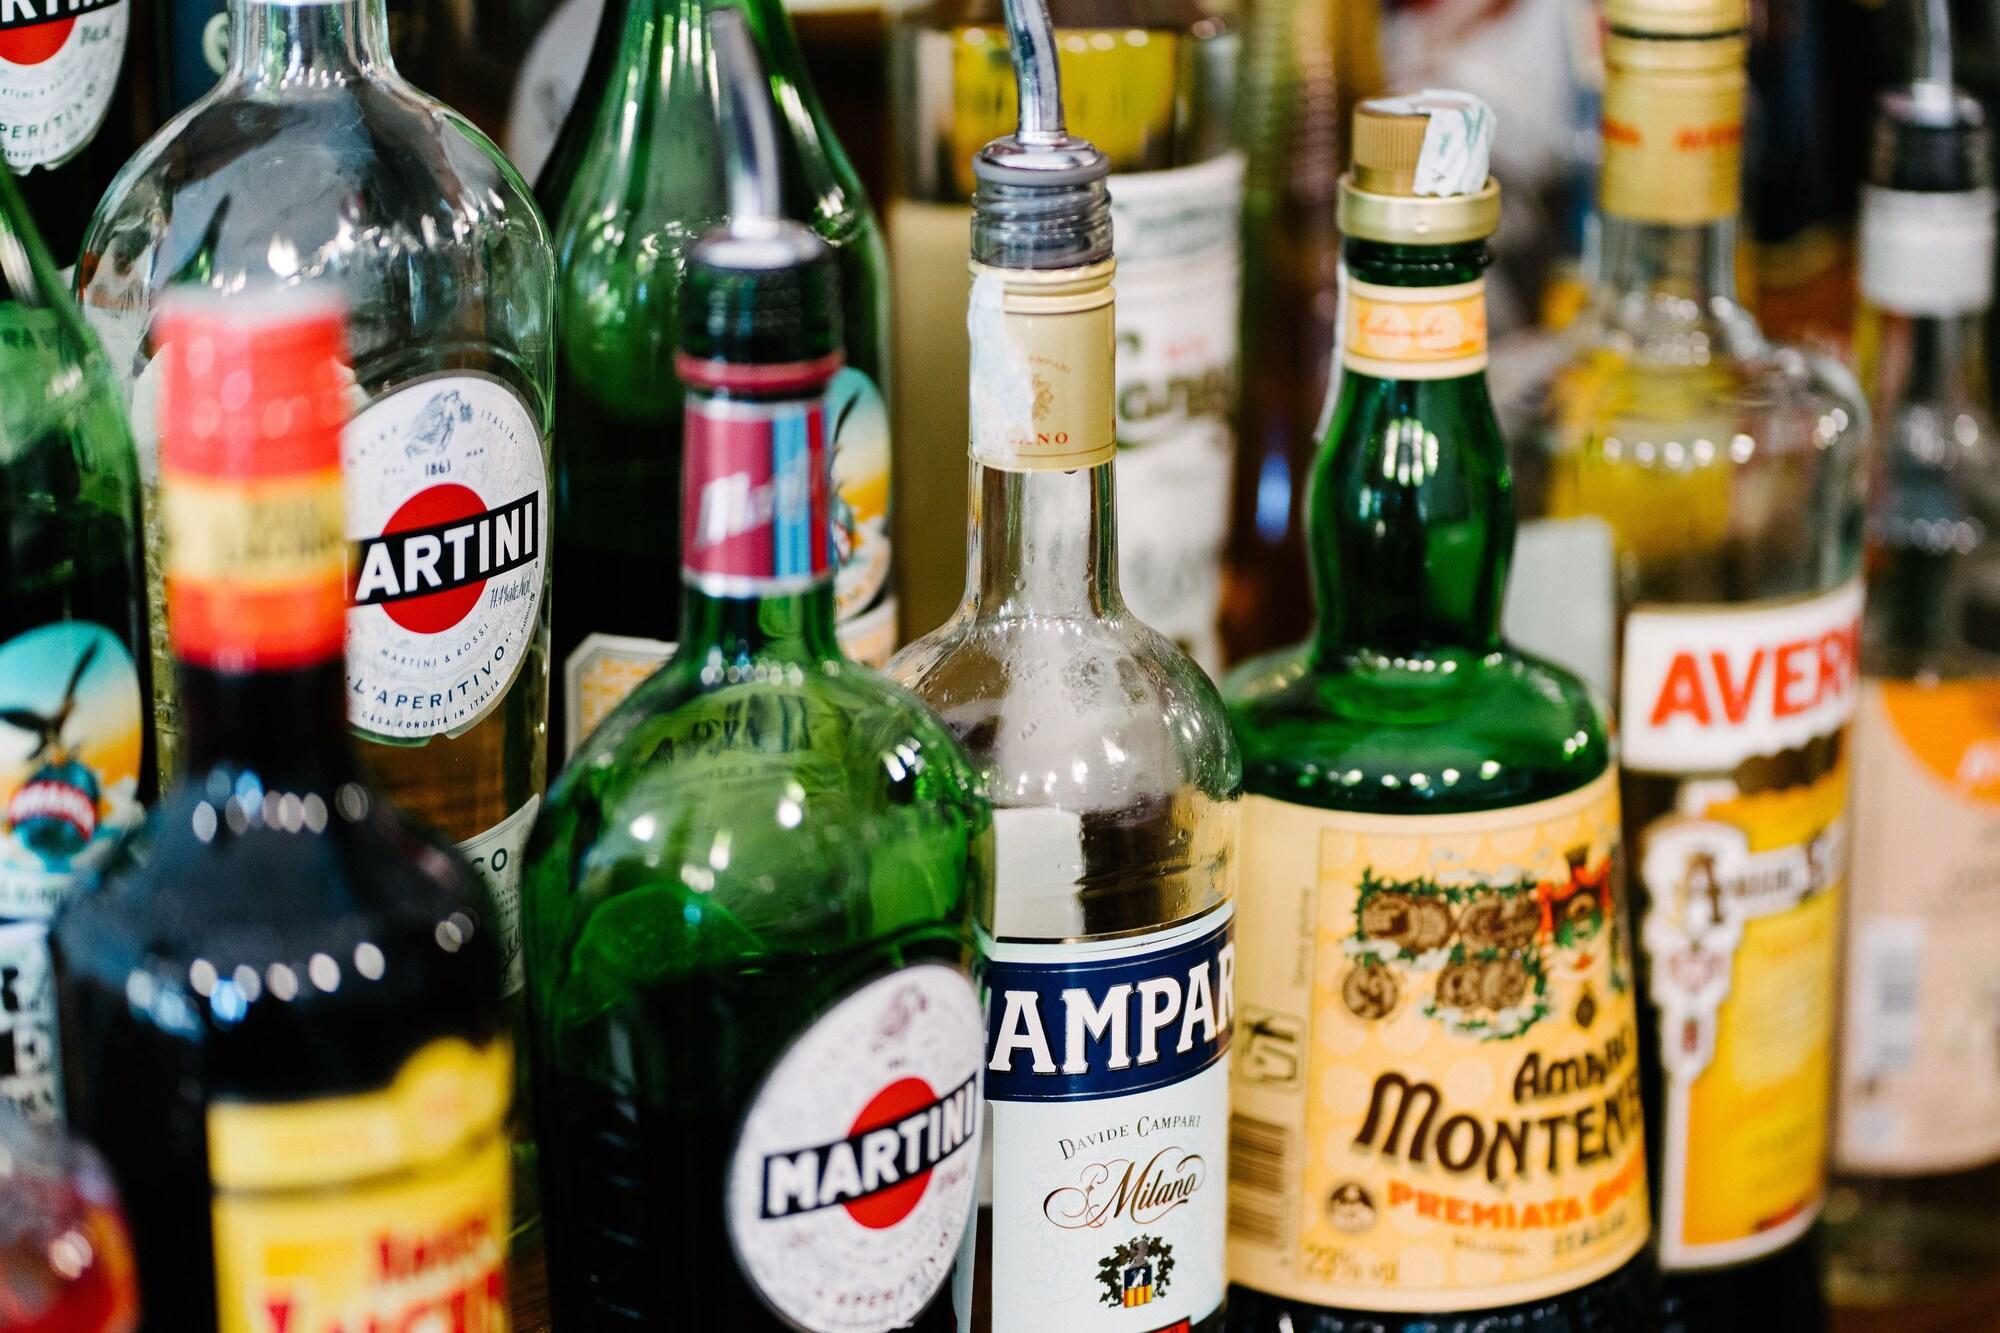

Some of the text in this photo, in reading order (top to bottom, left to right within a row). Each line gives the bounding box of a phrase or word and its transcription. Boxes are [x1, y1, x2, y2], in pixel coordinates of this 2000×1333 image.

[354, 502, 533, 601] ARTINI
[381, 649, 437, 667] MARTINI
[457, 623, 490, 657] ROSSI
[397, 716, 448, 729] FONDATA
[454, 709, 465, 720] IN
[470, 680, 501, 711] ITALIA
[471, 847, 507, 878] CO
[984, 943, 1236, 1075] AMPAR
[766, 1083, 976, 1217] MARTINI
[1043, 1146, 1207, 1229] Milano
[1387, 1180, 1584, 1230] PREMIATA
